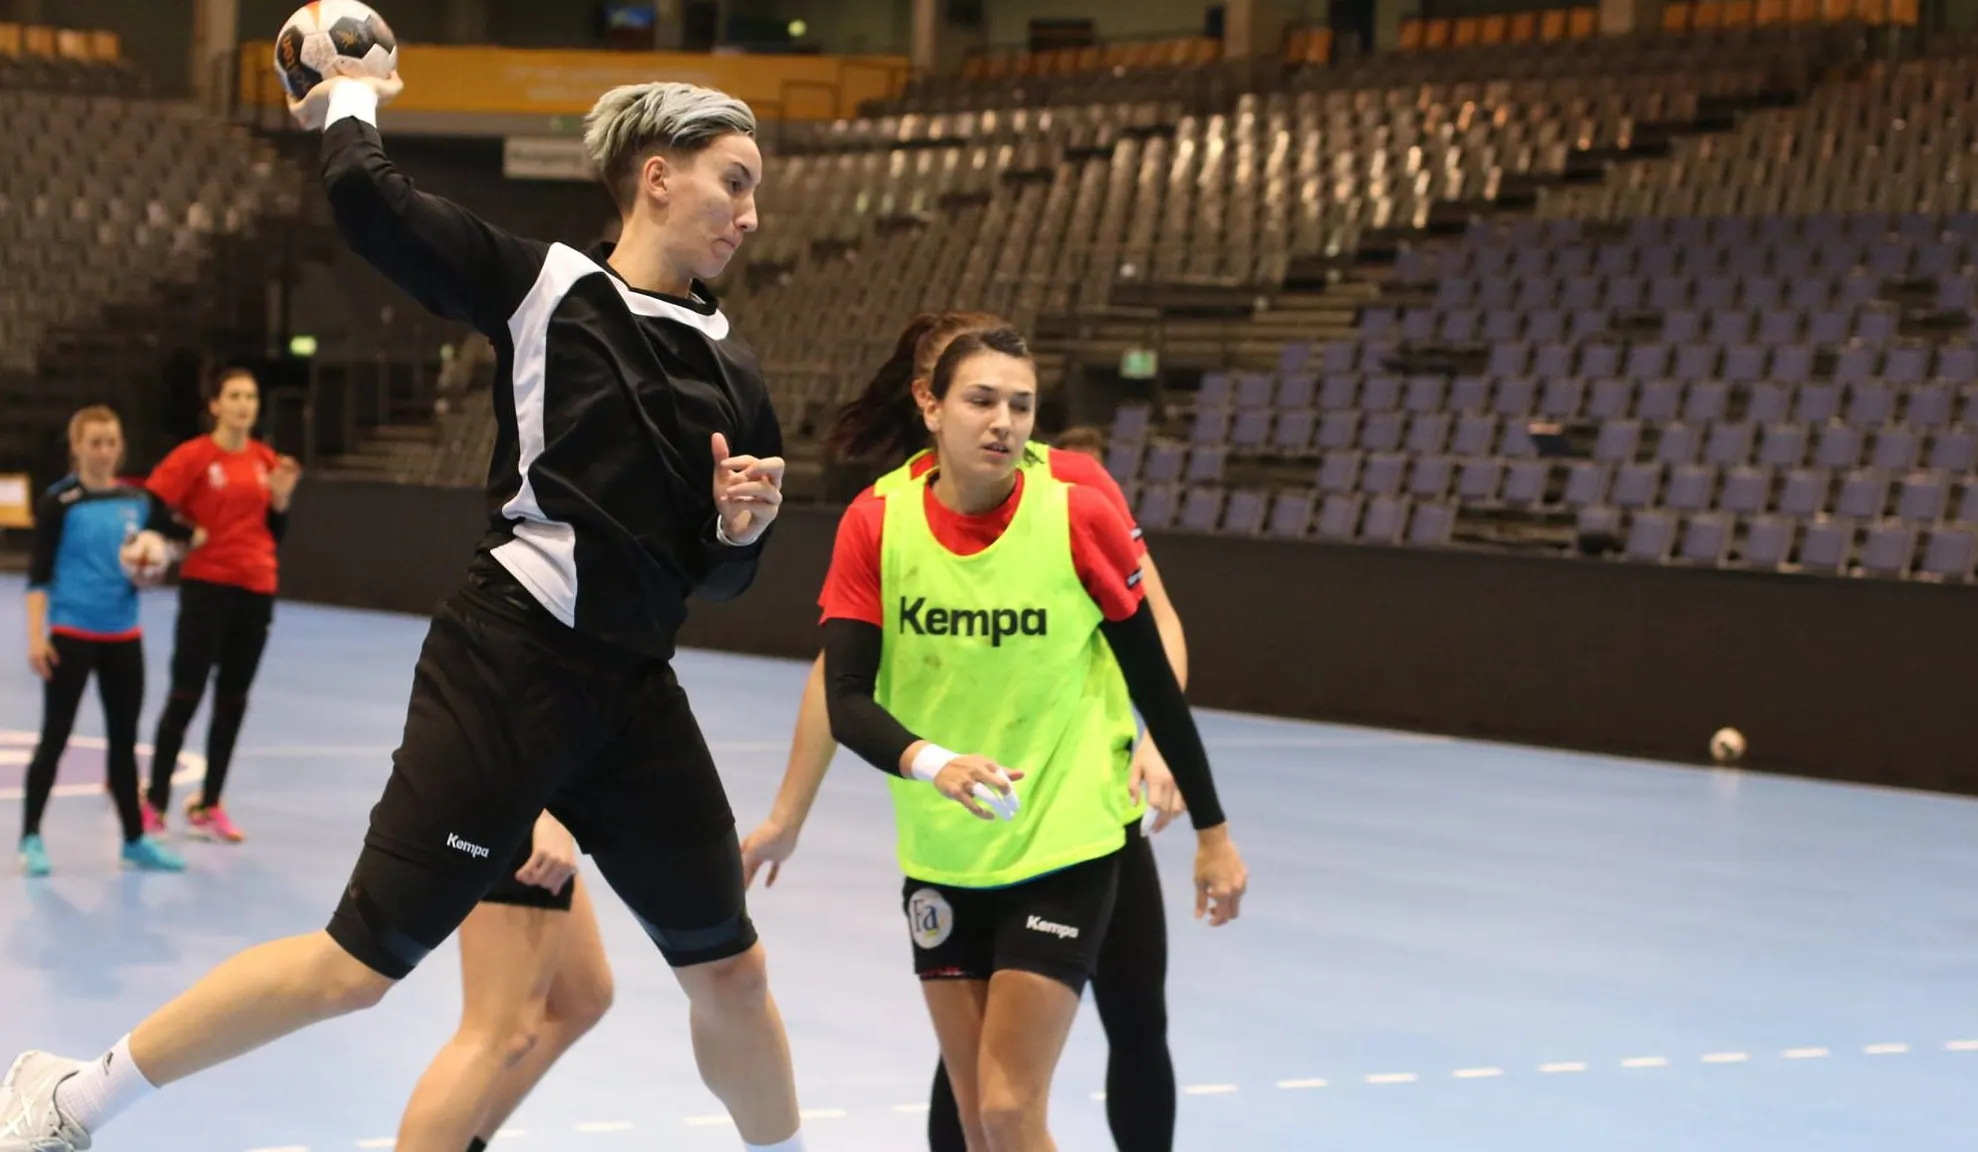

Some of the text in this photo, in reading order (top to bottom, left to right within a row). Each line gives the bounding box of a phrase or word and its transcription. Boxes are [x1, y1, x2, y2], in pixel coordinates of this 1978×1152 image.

[899, 596, 1046, 647] Kempa
[446, 832, 490, 858] Kempa
[911, 899, 939, 932] Fa
[1026, 914, 1079, 939] Kempa
